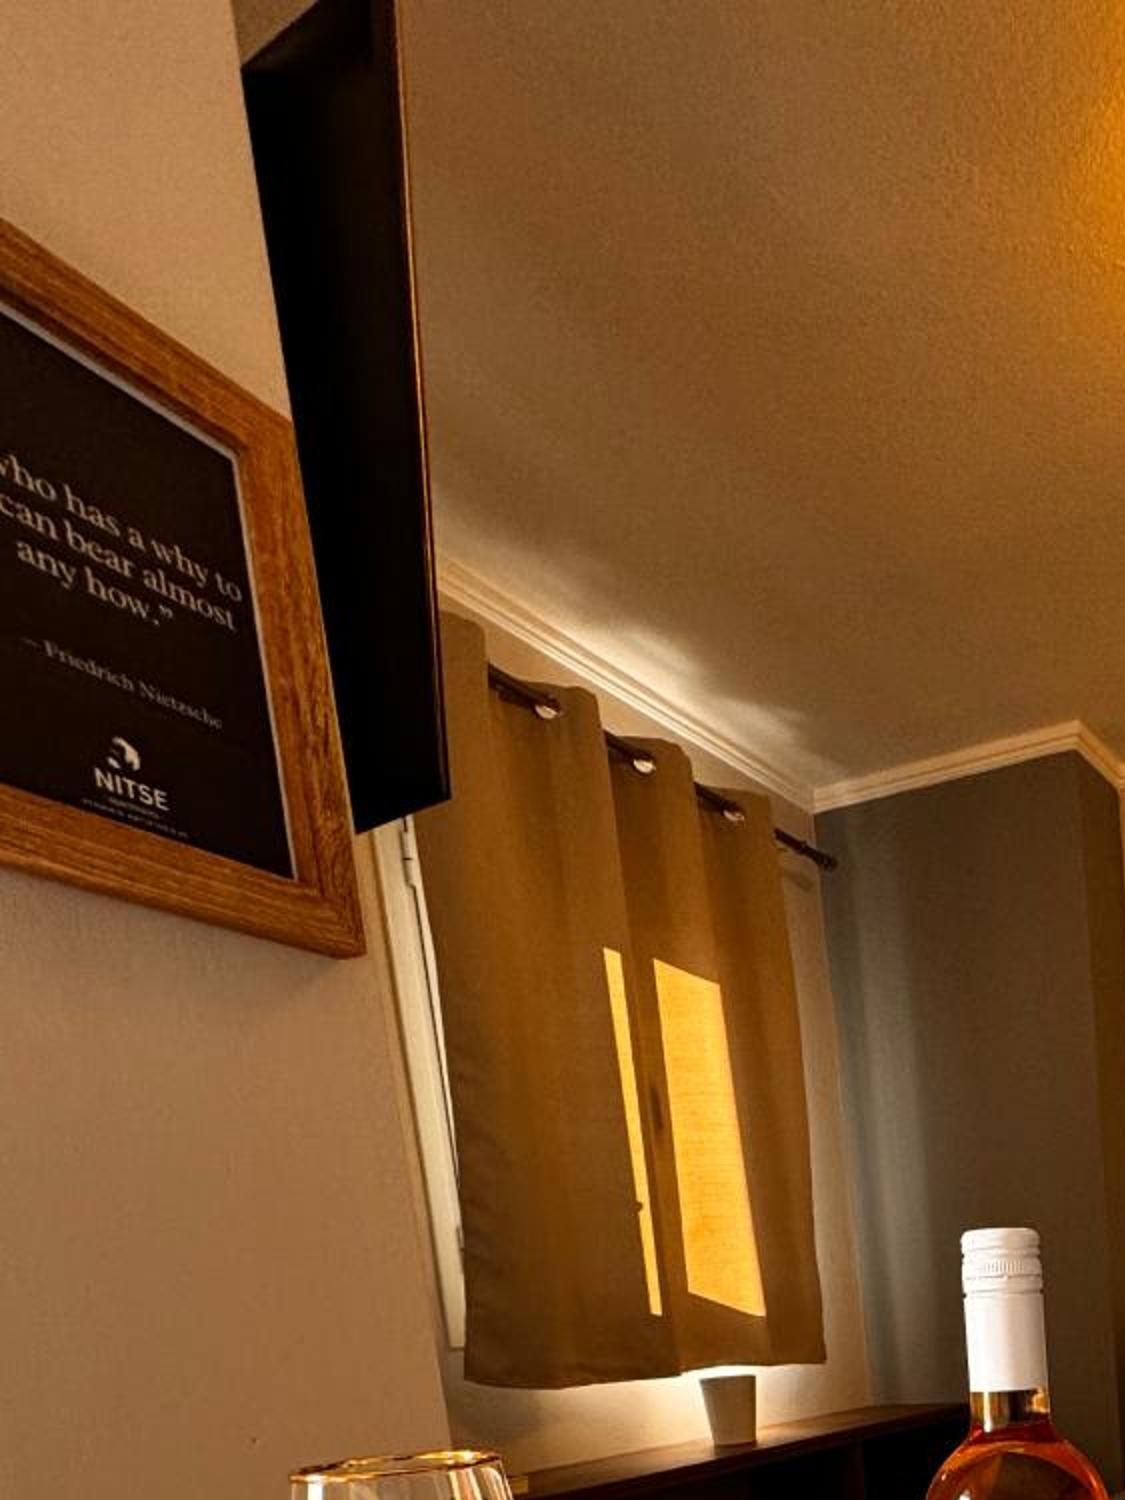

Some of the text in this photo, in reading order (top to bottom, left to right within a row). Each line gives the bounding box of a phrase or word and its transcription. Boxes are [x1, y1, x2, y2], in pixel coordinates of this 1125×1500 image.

[0, 493, 237, 632] can bear almost
[16, 541, 77, 590] any
[64, 483, 121, 537] has
[128, 527, 146, 551] a
[150, 539, 209, 588] why
[215, 571, 243, 602] to
[43, 639, 136, 693] Friedrich
[94, 766, 171, 812] NITSE
